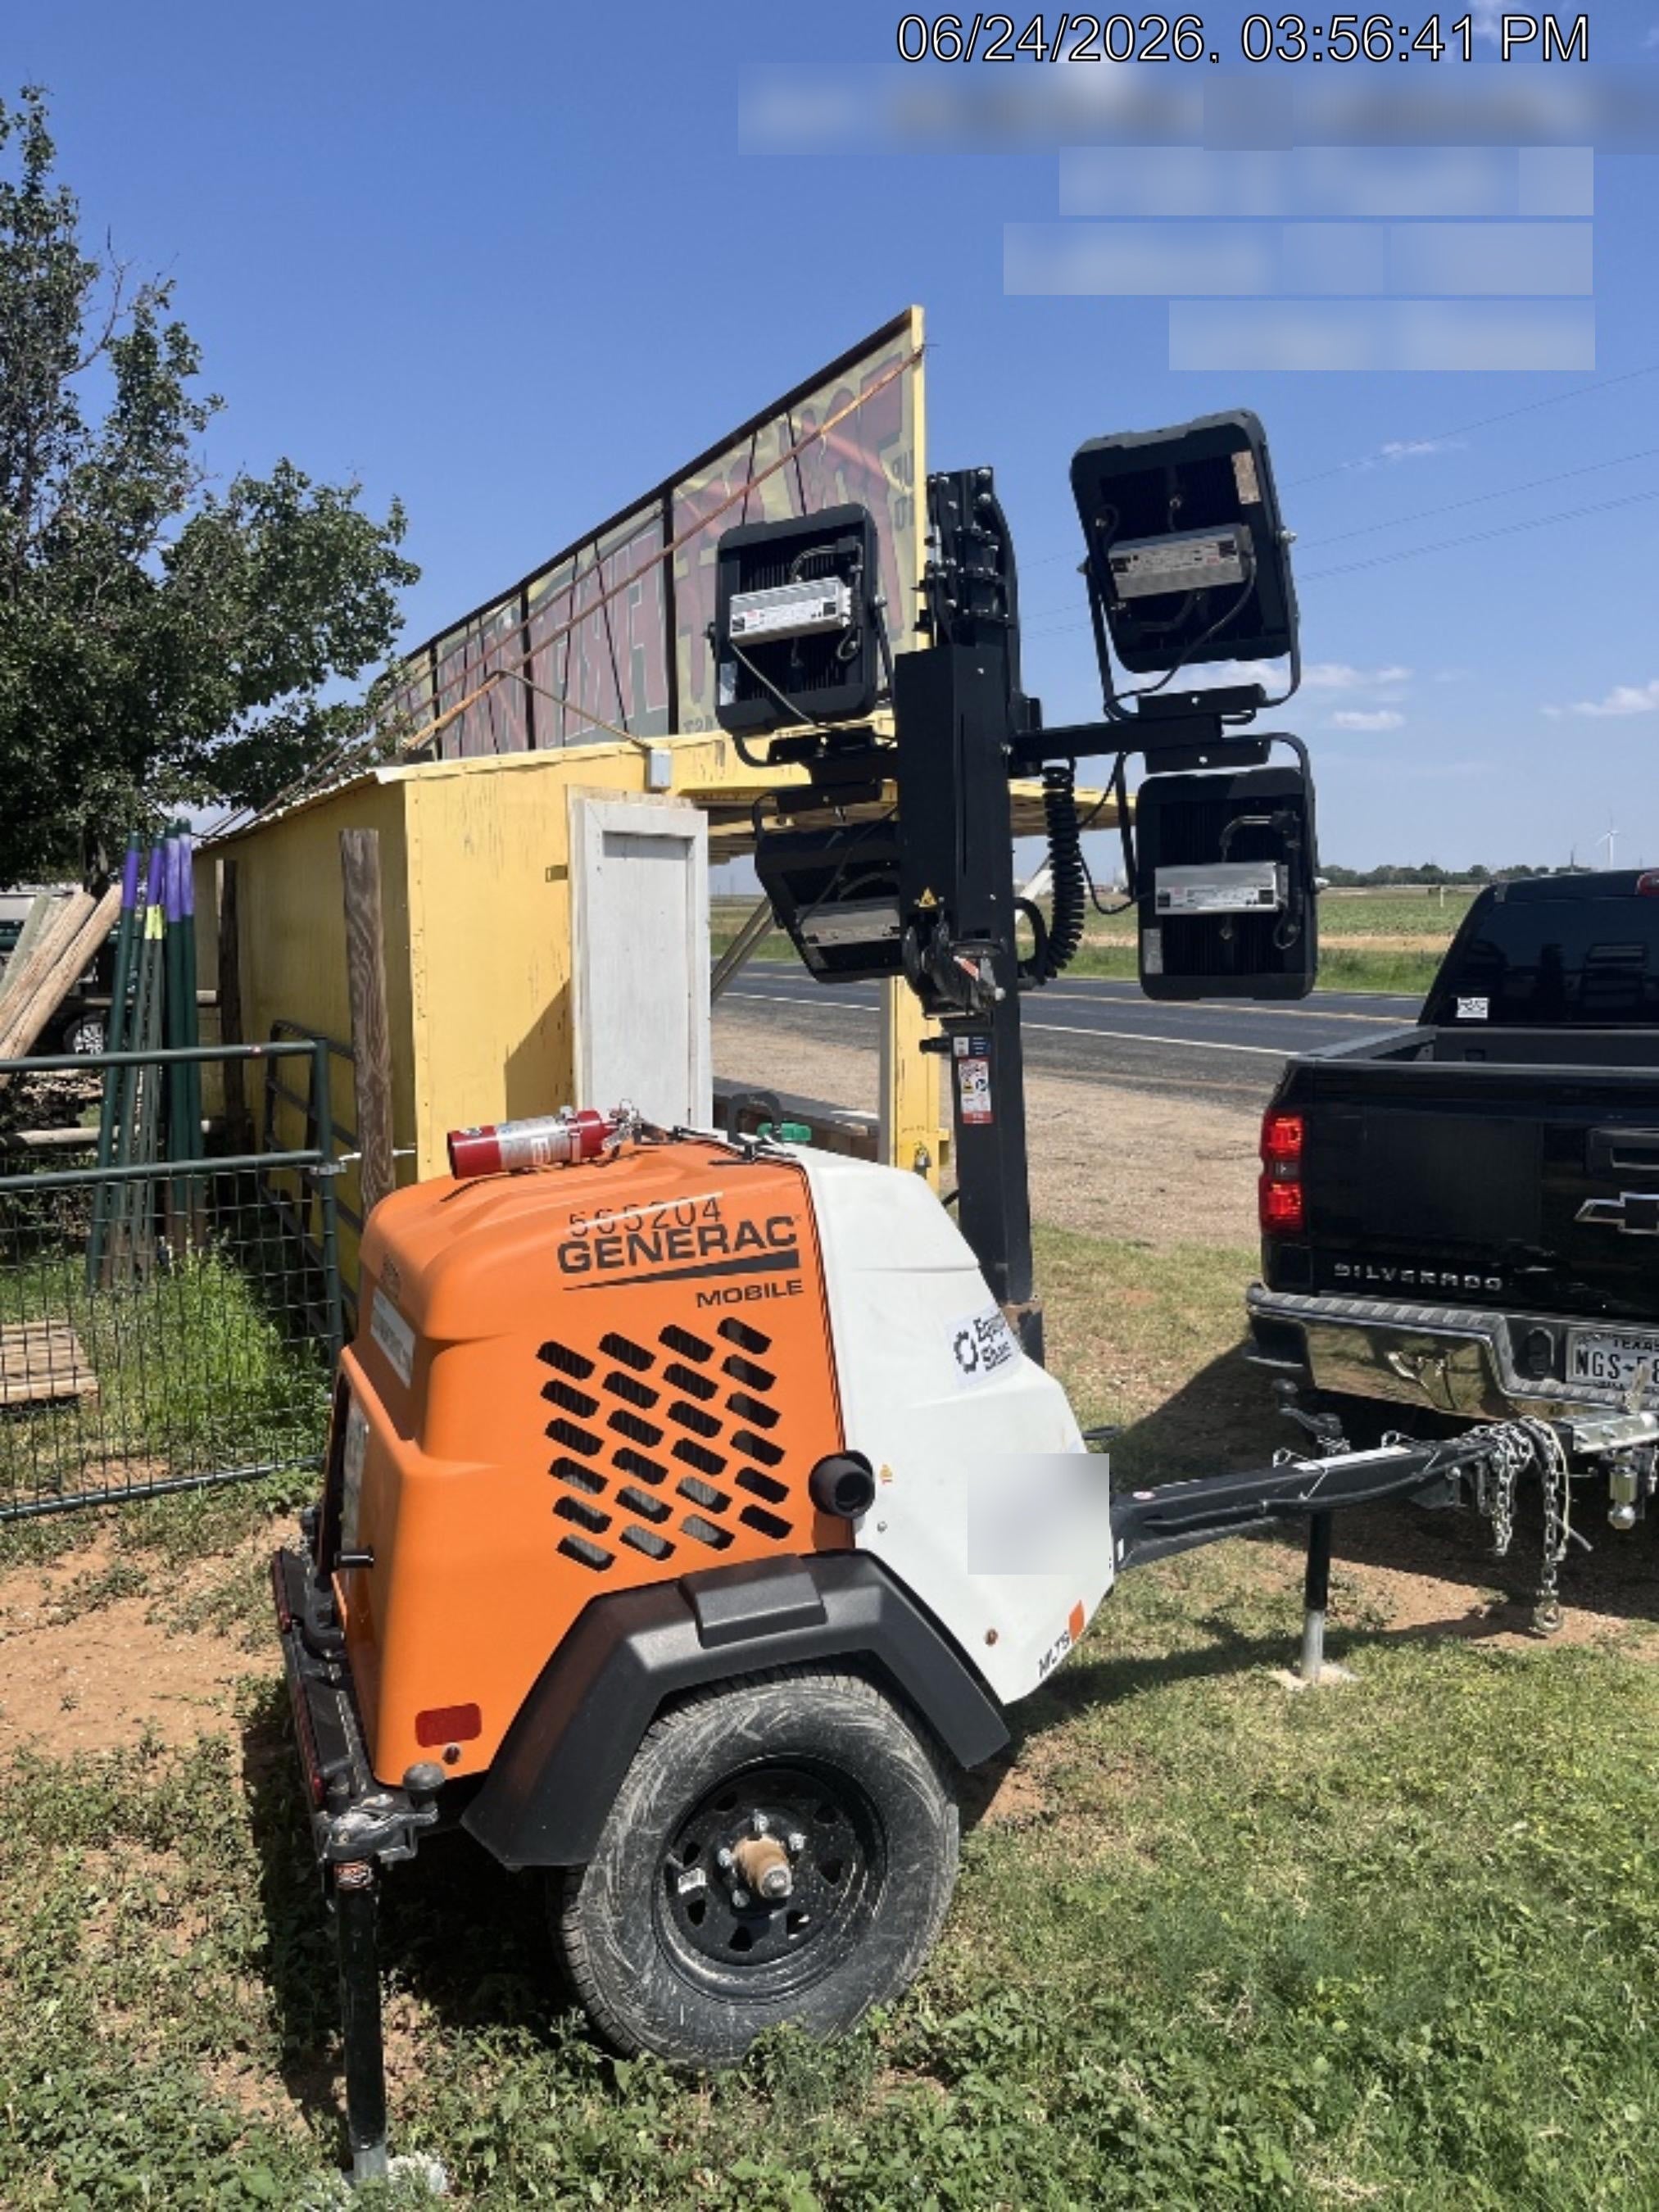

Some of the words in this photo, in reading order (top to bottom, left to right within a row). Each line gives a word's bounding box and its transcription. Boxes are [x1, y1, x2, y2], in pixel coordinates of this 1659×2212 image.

[557, 1215, 797, 1274] GENERAC
[1334, 1262, 1503, 1291] SILVERADO
[696, 1279, 804, 1308] MOBILE
